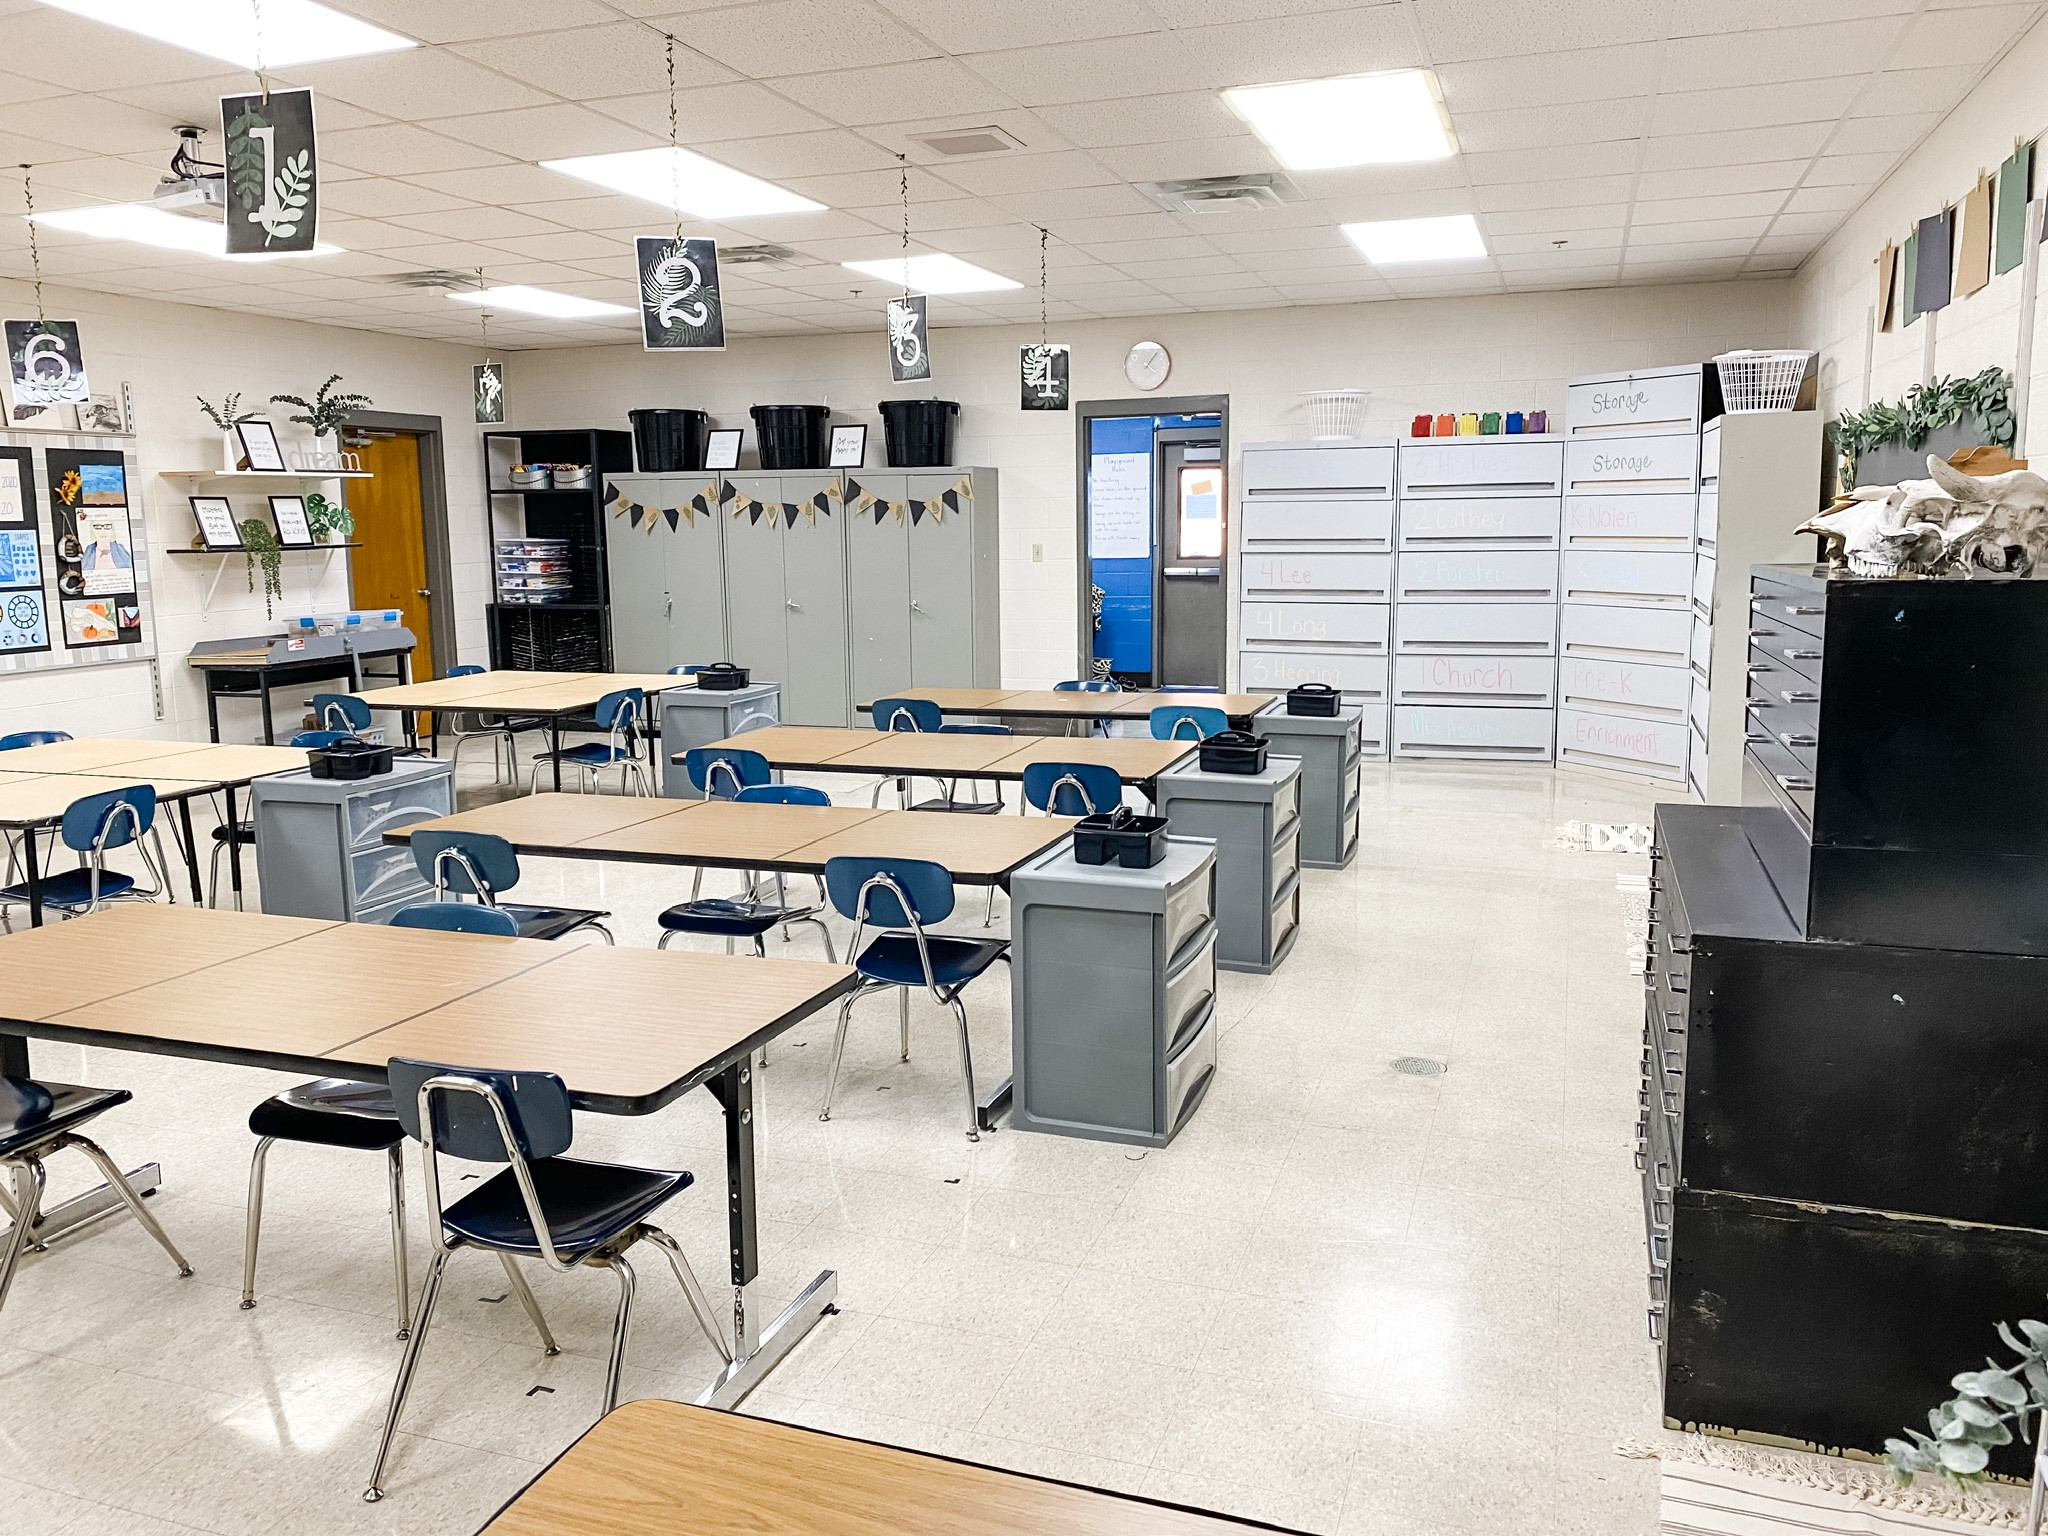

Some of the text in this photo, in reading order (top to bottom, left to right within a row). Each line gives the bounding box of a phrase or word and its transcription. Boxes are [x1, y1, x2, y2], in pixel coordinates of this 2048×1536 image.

[248, 126, 292, 222] 1
[656, 257, 707, 328] 2
[896, 313, 920, 366] 3
[25, 333, 71, 390] 6
[1030, 355, 1059, 398] 4
[1592, 391, 1649, 414] Storage
[288, 442, 363, 471] dream
[1592, 454, 1653, 474] Storage
[1412, 503, 1505, 532] 2 Cathey
[1571, 502, 1638, 529] K Nolen
[1261, 559, 1312, 586] 4 Lee
[1415, 560, 1432, 583] 2
[1257, 608, 1326, 640] 4 Long
[1252, 657, 1269, 682] 3
[1433, 656, 1512, 689] Church
[1575, 661, 1633, 695] Pre-K
[1576, 717, 1661, 756] Enrichment
